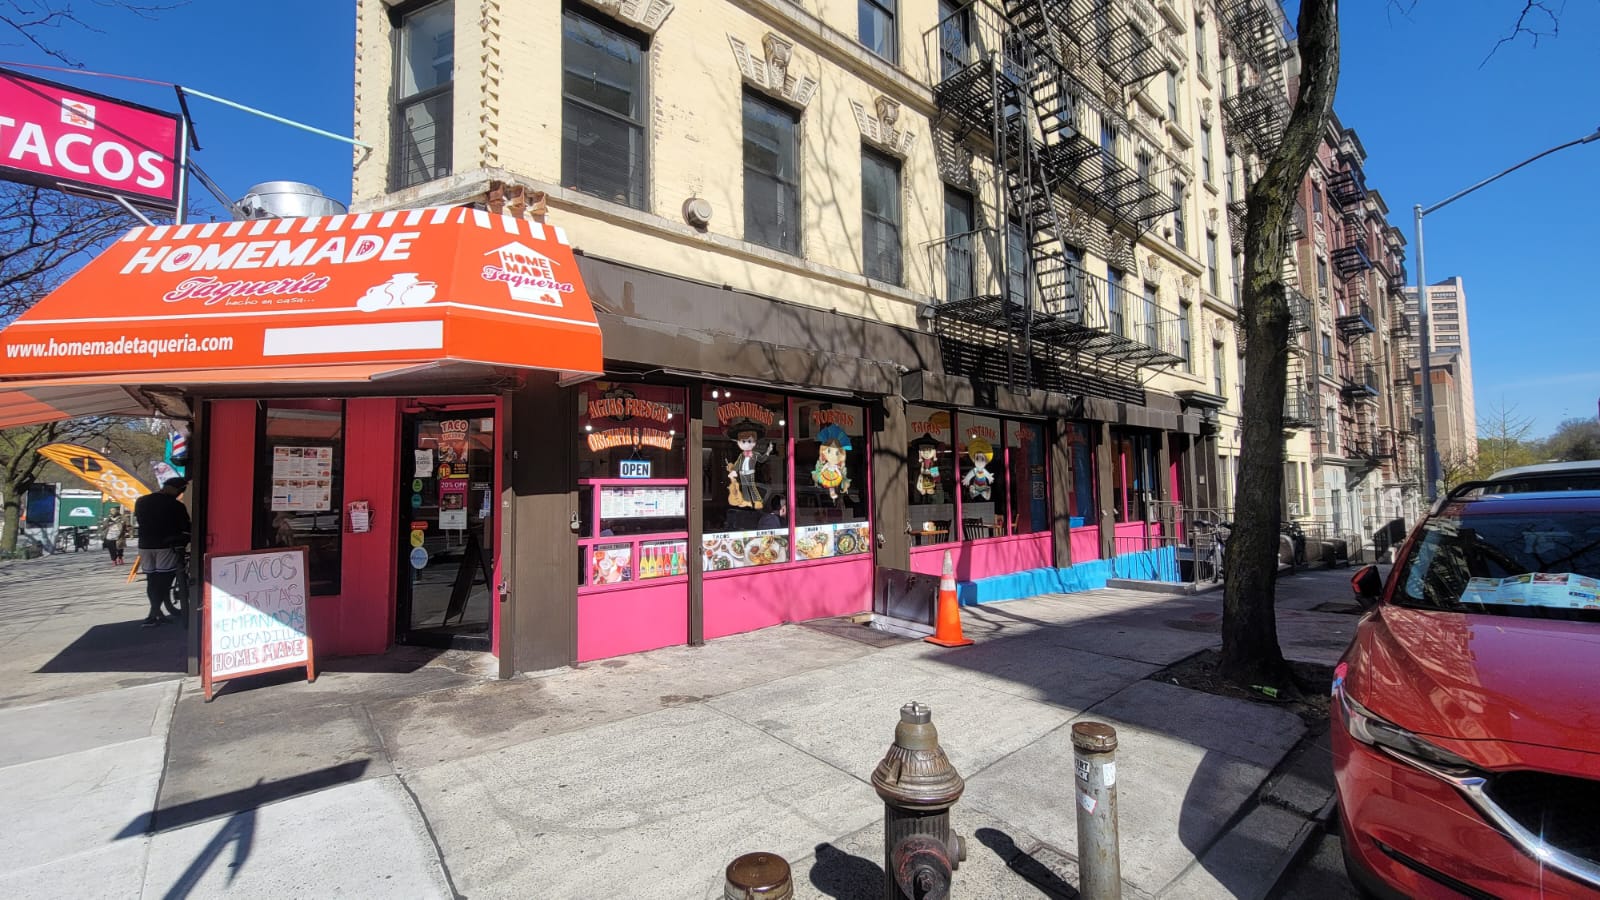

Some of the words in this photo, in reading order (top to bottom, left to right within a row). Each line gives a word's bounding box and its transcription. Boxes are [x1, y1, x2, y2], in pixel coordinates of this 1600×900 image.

[119, 231, 421, 275] HOMEMADE
[502, 251, 549, 269] HOME
[505, 262, 553, 280] MADE
[6, 333, 233, 358] www.homemadetaqueria.com
[588, 398, 624, 420] AGUAS
[812, 408, 855, 426] TORTAS
[440, 420, 468, 432] TACO
[911, 421, 942, 436] TACOS
[622, 463, 649, 476] OPEN
[224, 553, 298, 585] TACOS
[213, 647, 258, 672] HOME
[262, 638, 305, 663] MADE
